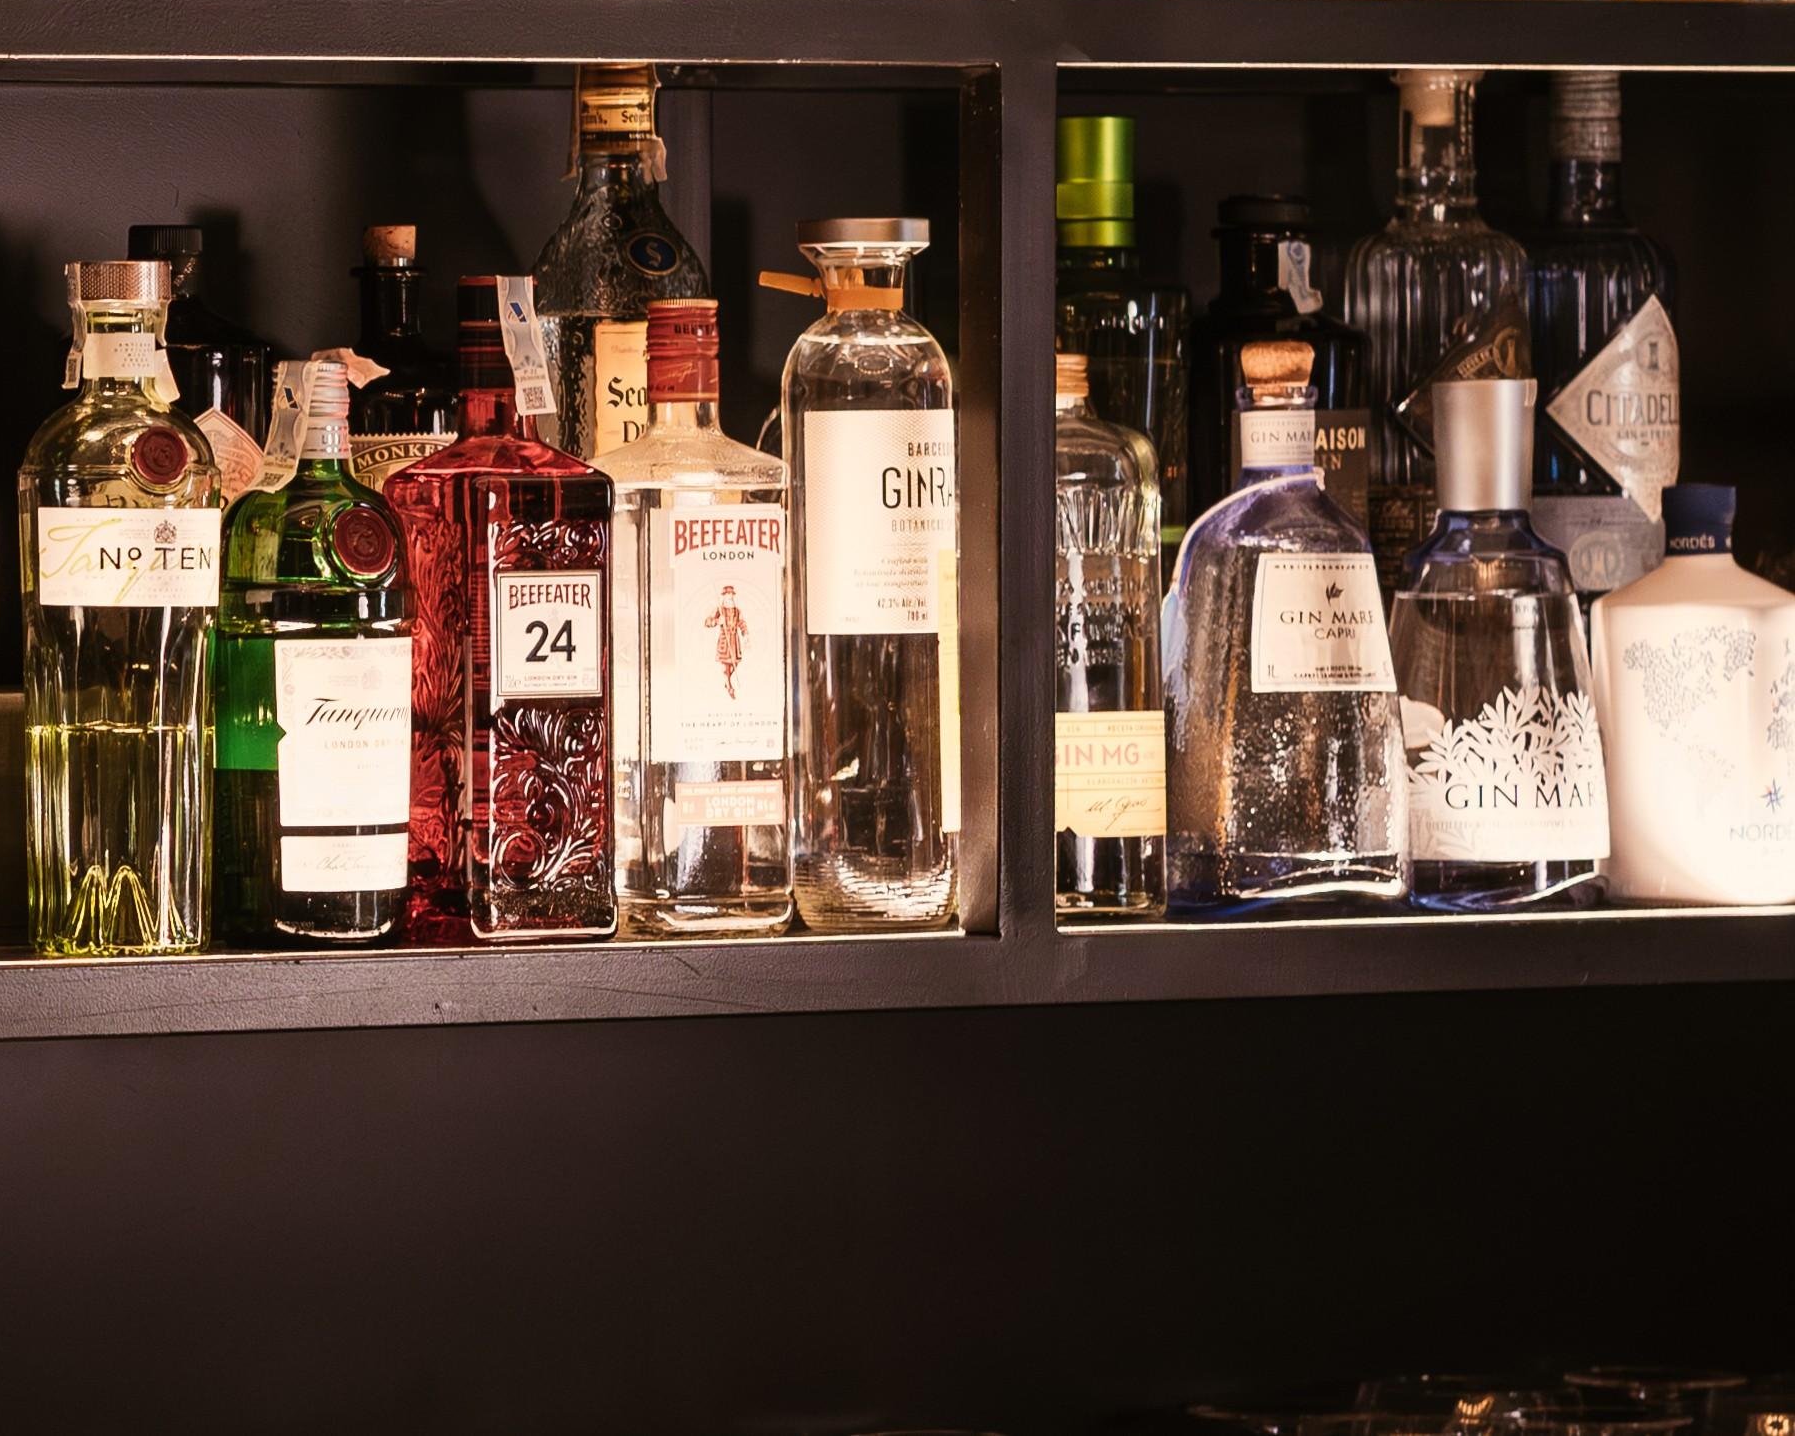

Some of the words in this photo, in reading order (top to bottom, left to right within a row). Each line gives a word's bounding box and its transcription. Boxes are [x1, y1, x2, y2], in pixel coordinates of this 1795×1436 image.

[1250, 431, 1280, 444] GIN
[1315, 427, 1366, 450] AISON
[357, 442, 441, 467] MONKE
[674, 517, 781, 556] BEEFEATER
[154, 547, 212, 571] TEN
[702, 551, 755, 561] LONDON
[508, 583, 592, 610] BEEFEATER
[1280, 610, 1323, 625] GIN
[525, 619, 577, 663] 24
[1314, 628, 1356, 640] CAPRI
[324, 739, 369, 750] LONDON
[1101, 742, 1140, 766] MG
[706, 795, 756, 808] LONDON
[1445, 783, 1518, 809] GIN
[1535, 782, 1595, 809] MAR
[706, 807, 738, 819] DRY
